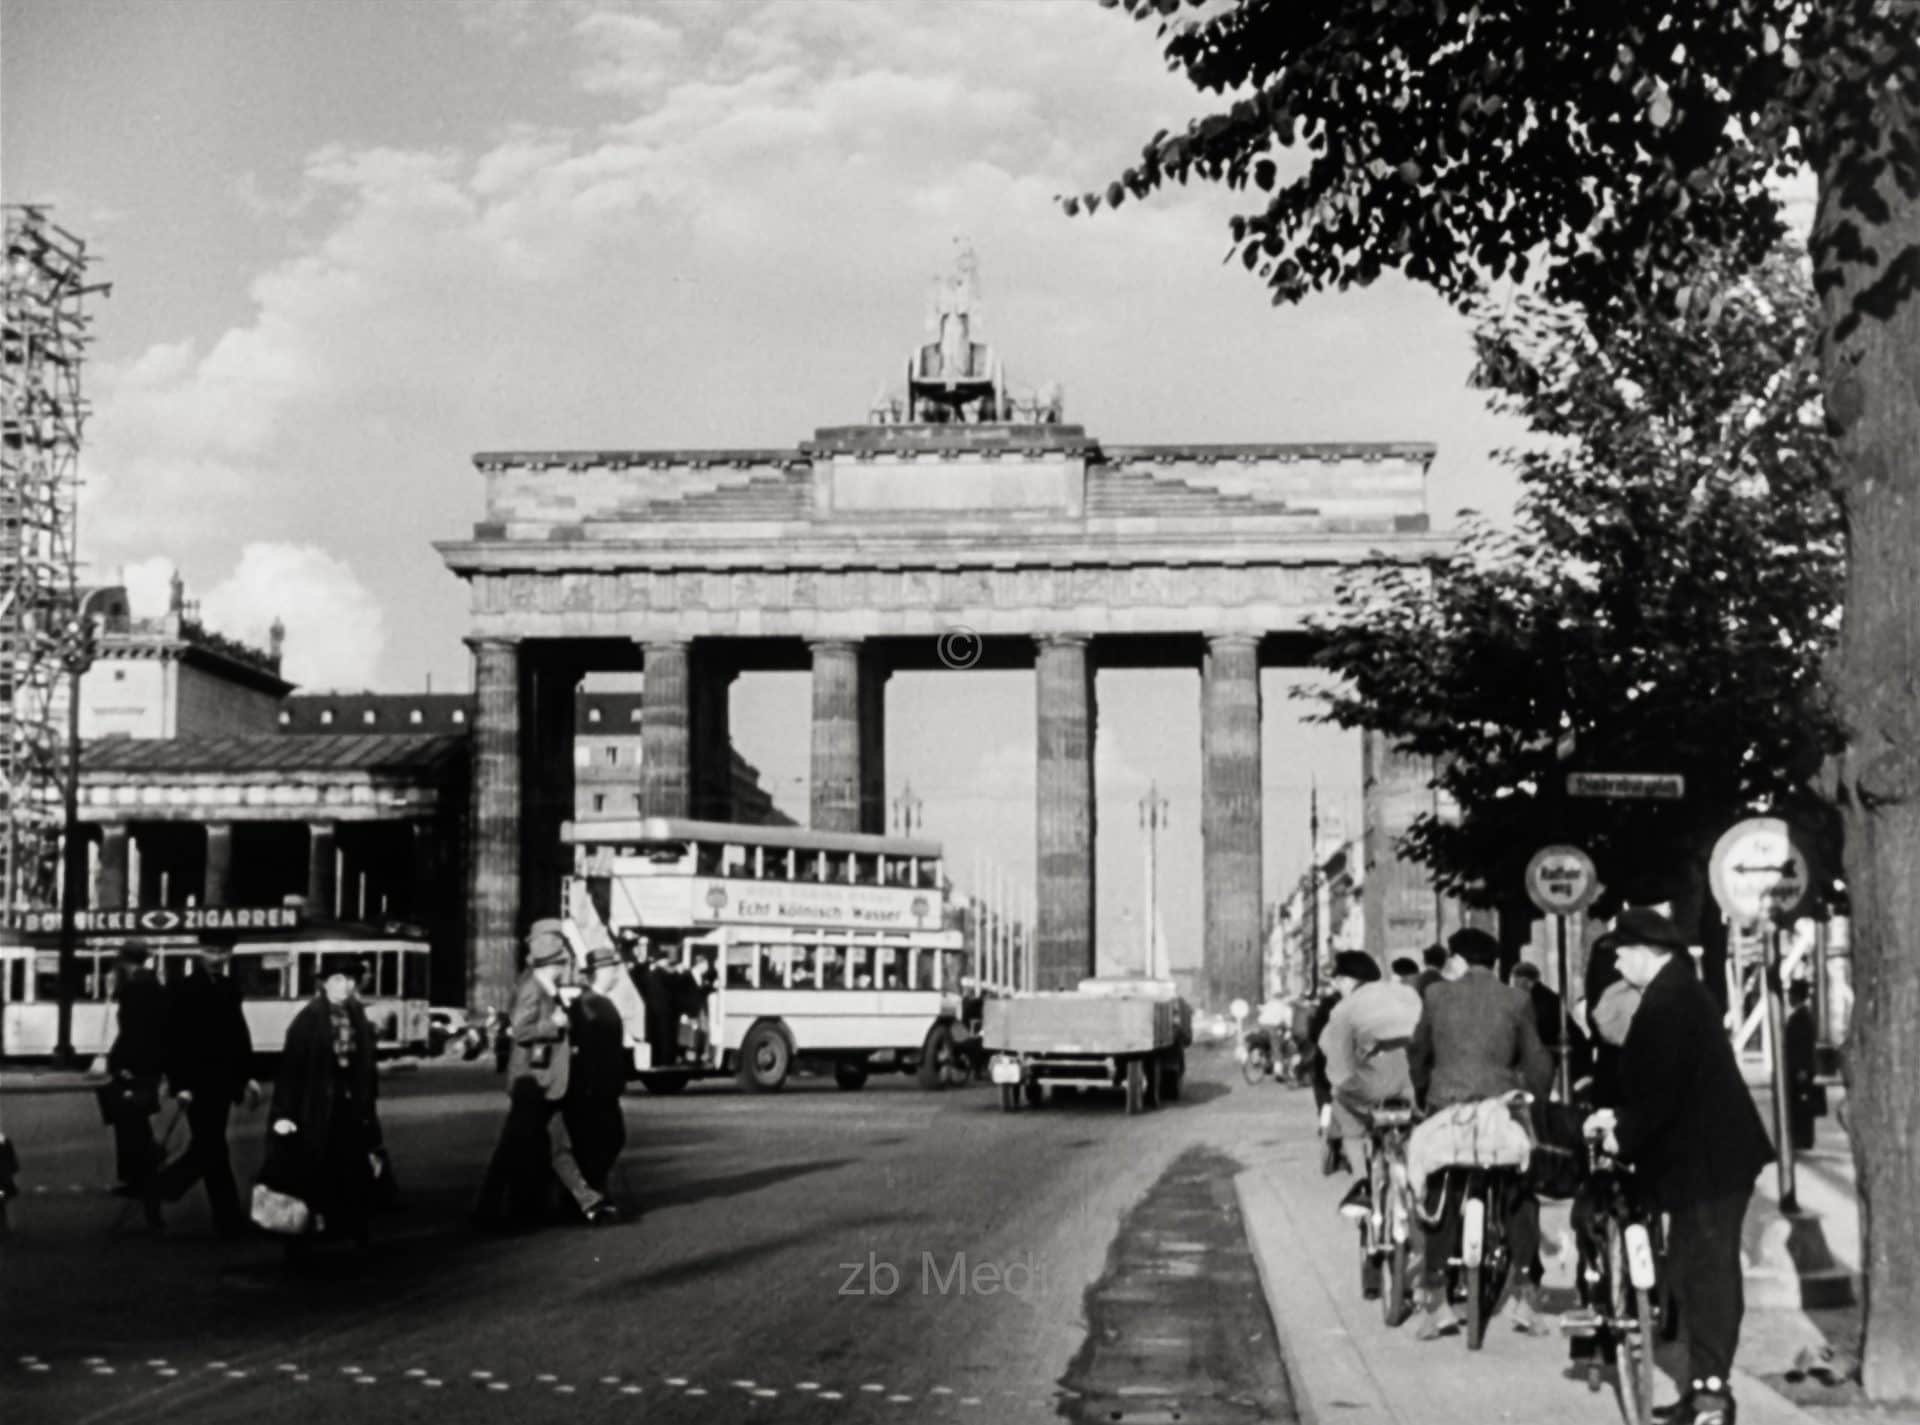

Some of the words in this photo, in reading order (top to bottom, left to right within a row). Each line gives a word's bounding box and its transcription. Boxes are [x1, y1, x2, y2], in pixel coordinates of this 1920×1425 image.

[185, 908, 296, 928] ZIGARREN
[738, 901, 770, 917] Echt
[853, 907, 901, 921] Wasser
